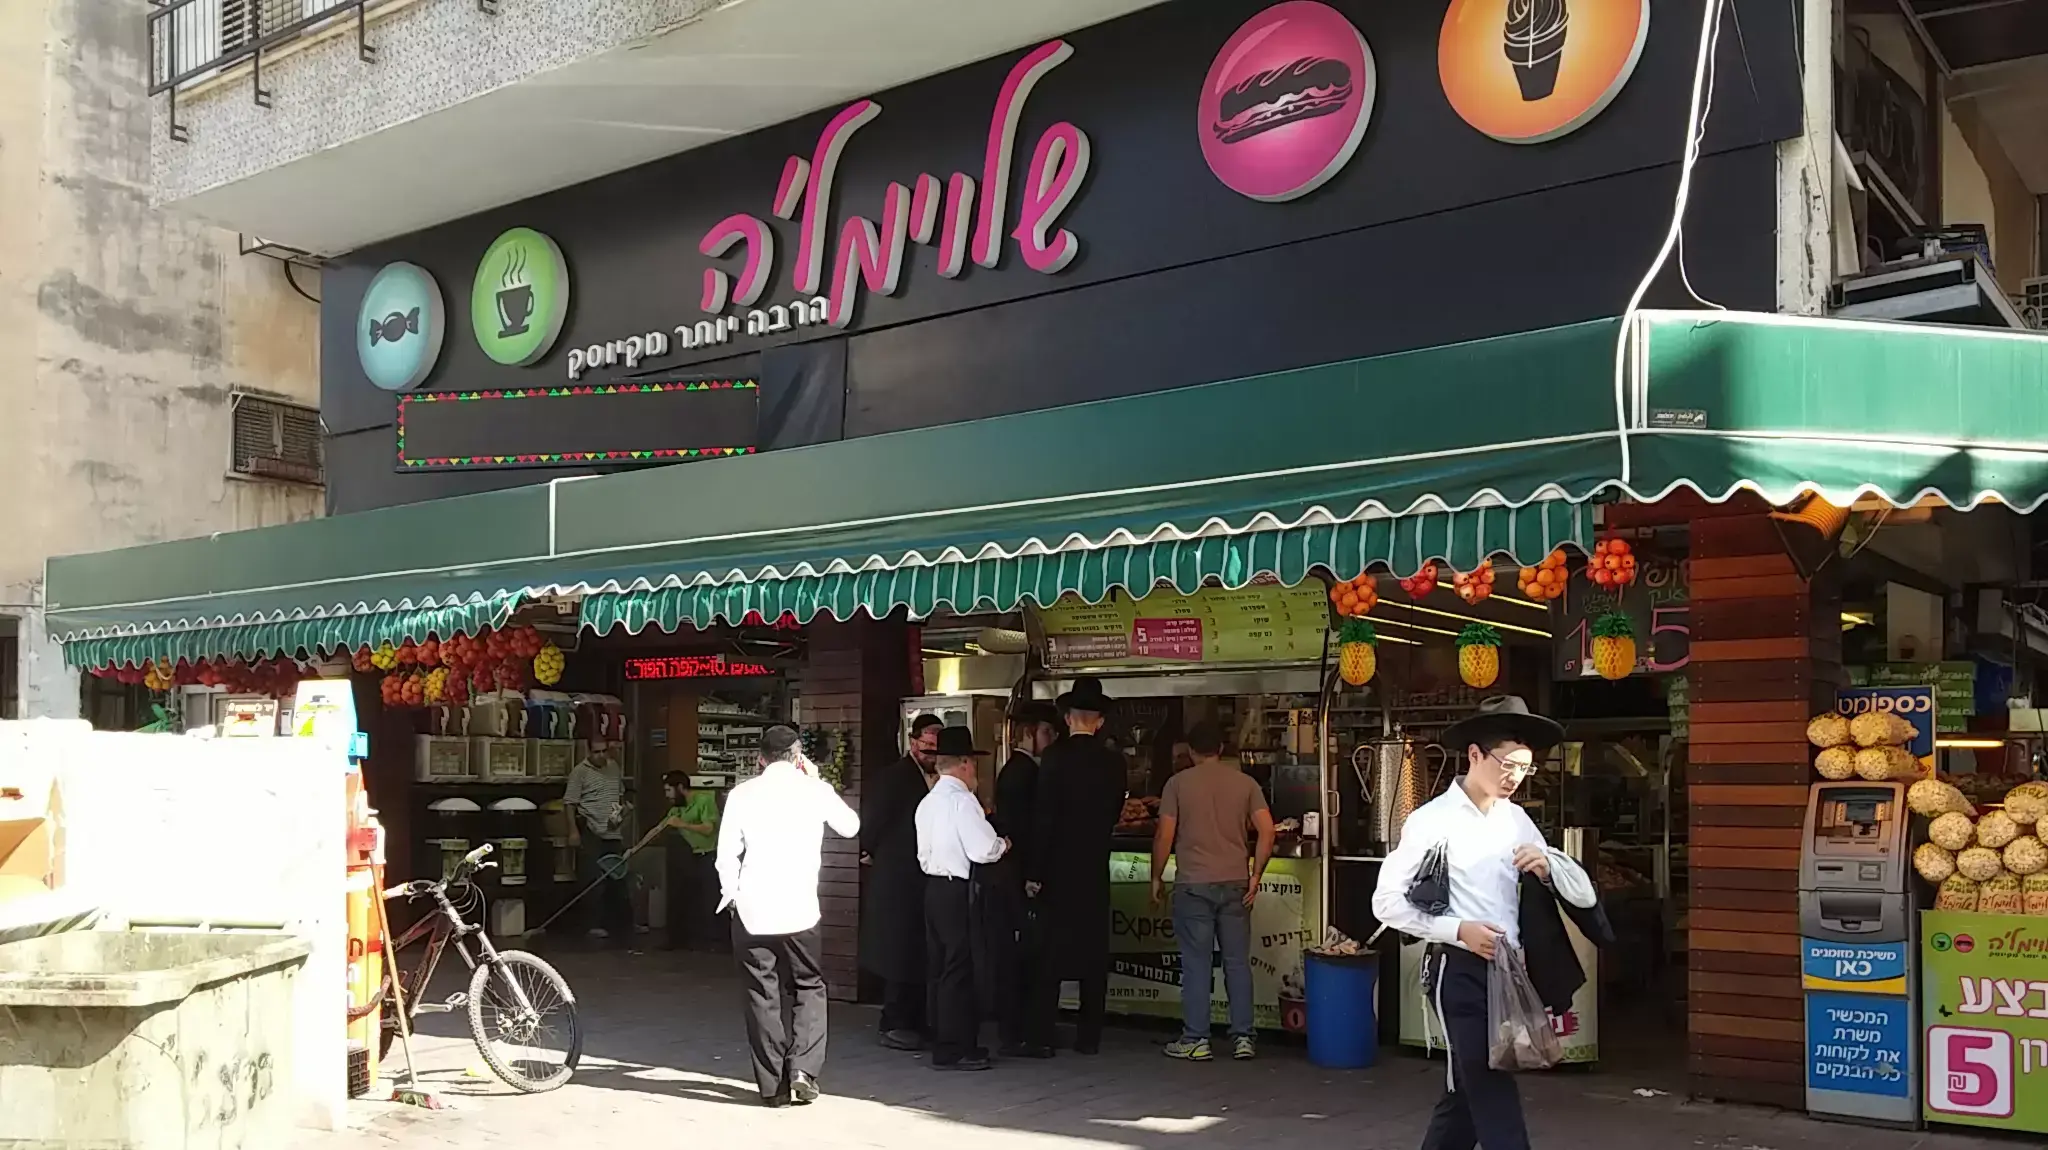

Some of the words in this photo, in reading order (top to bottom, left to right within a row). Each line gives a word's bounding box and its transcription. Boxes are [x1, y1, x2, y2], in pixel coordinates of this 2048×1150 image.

[699, 39, 1090, 328] שלוימל'ה
[747, 295, 829, 336] הרבה
[674, 314, 740, 350] יותר
[567, 330, 668, 379] מקיוסק
[1137, 627, 1148, 643] 5
[1128, 855, 1140, 880] מרקים
[1811, 947, 1854, 958] מזומנים
[1856, 948, 1897, 961] משיכת
[1115, 960, 1174, 983] המחירים
[1835, 960, 1872, 977] כאן
[1138, 988, 1160, 999] קפה
[1826, 1008, 1888, 1025] המכשיר
[1832, 1027, 1881, 1043] משרת
[1815, 1044, 1870, 1062] לקוחות
[1875, 1049, 1901, 1063] את
[1815, 1061, 1874, 1079] הבנקים
[1947, 1034, 1998, 1107] 5
